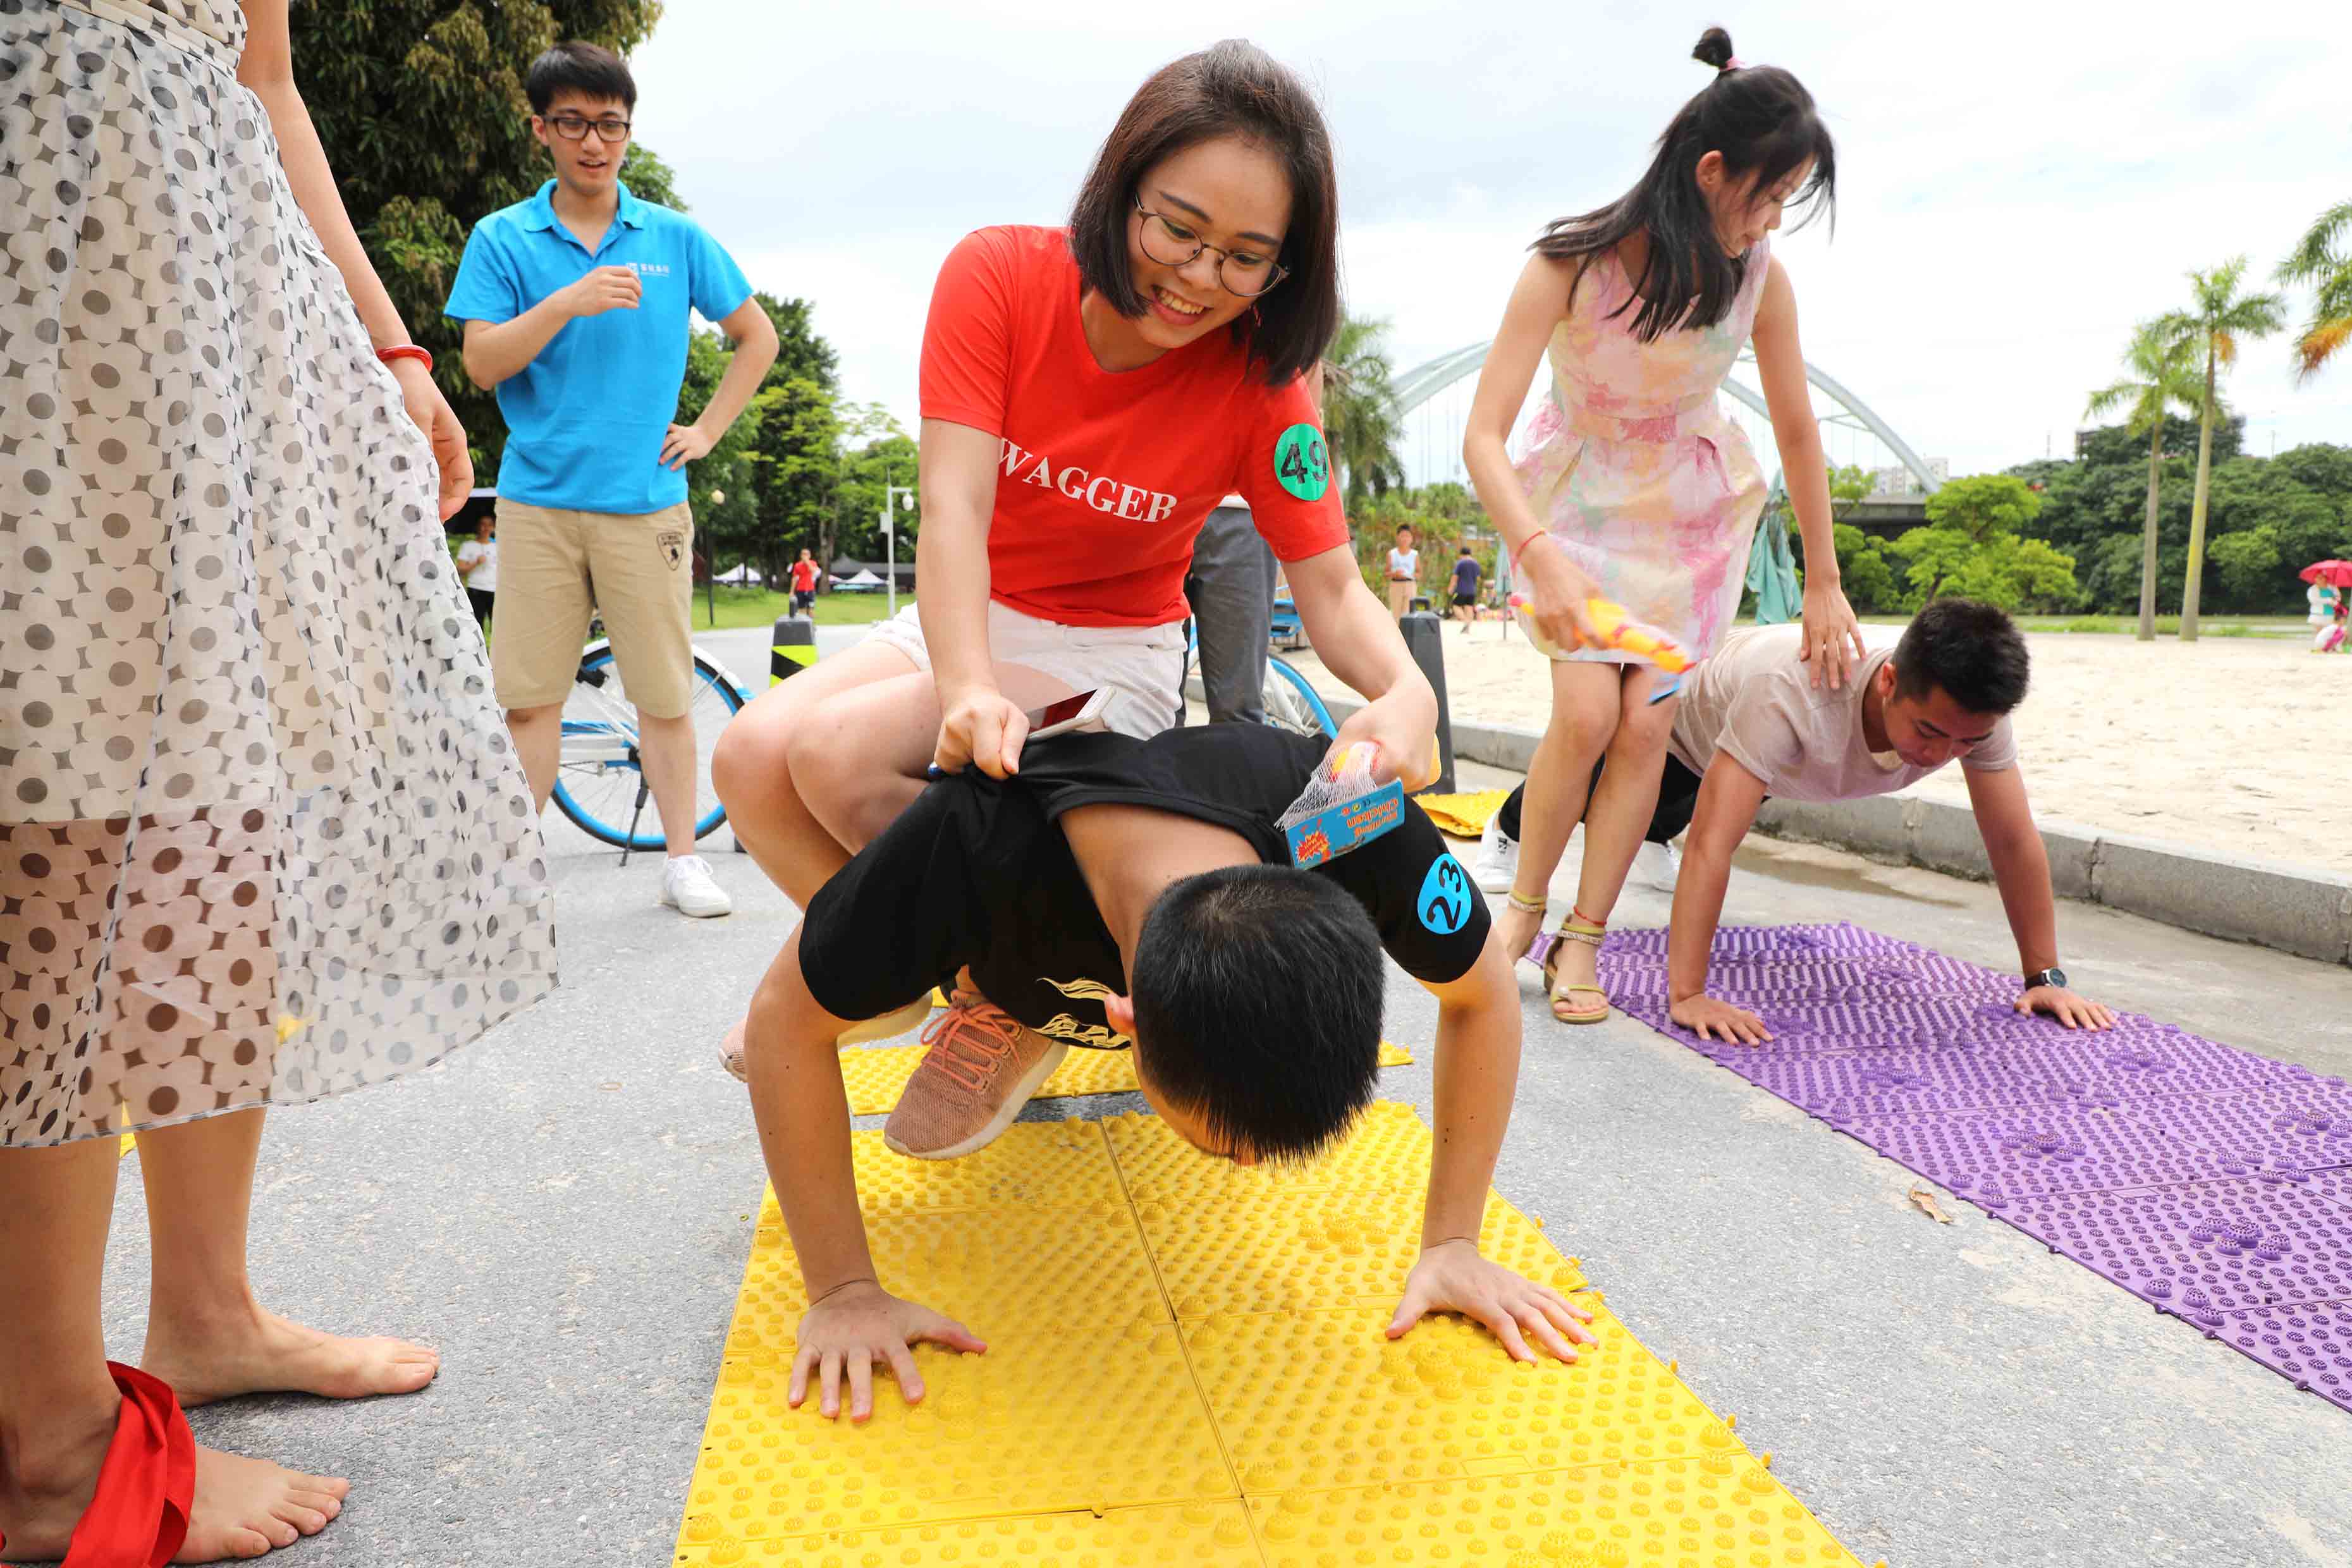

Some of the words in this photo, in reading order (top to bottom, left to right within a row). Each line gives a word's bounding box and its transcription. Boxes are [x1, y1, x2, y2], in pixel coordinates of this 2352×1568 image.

[998, 437, 1177, 522] WAGGER
[1281, 441, 1326, 484] 49
[1426, 859, 1462, 930] 23
